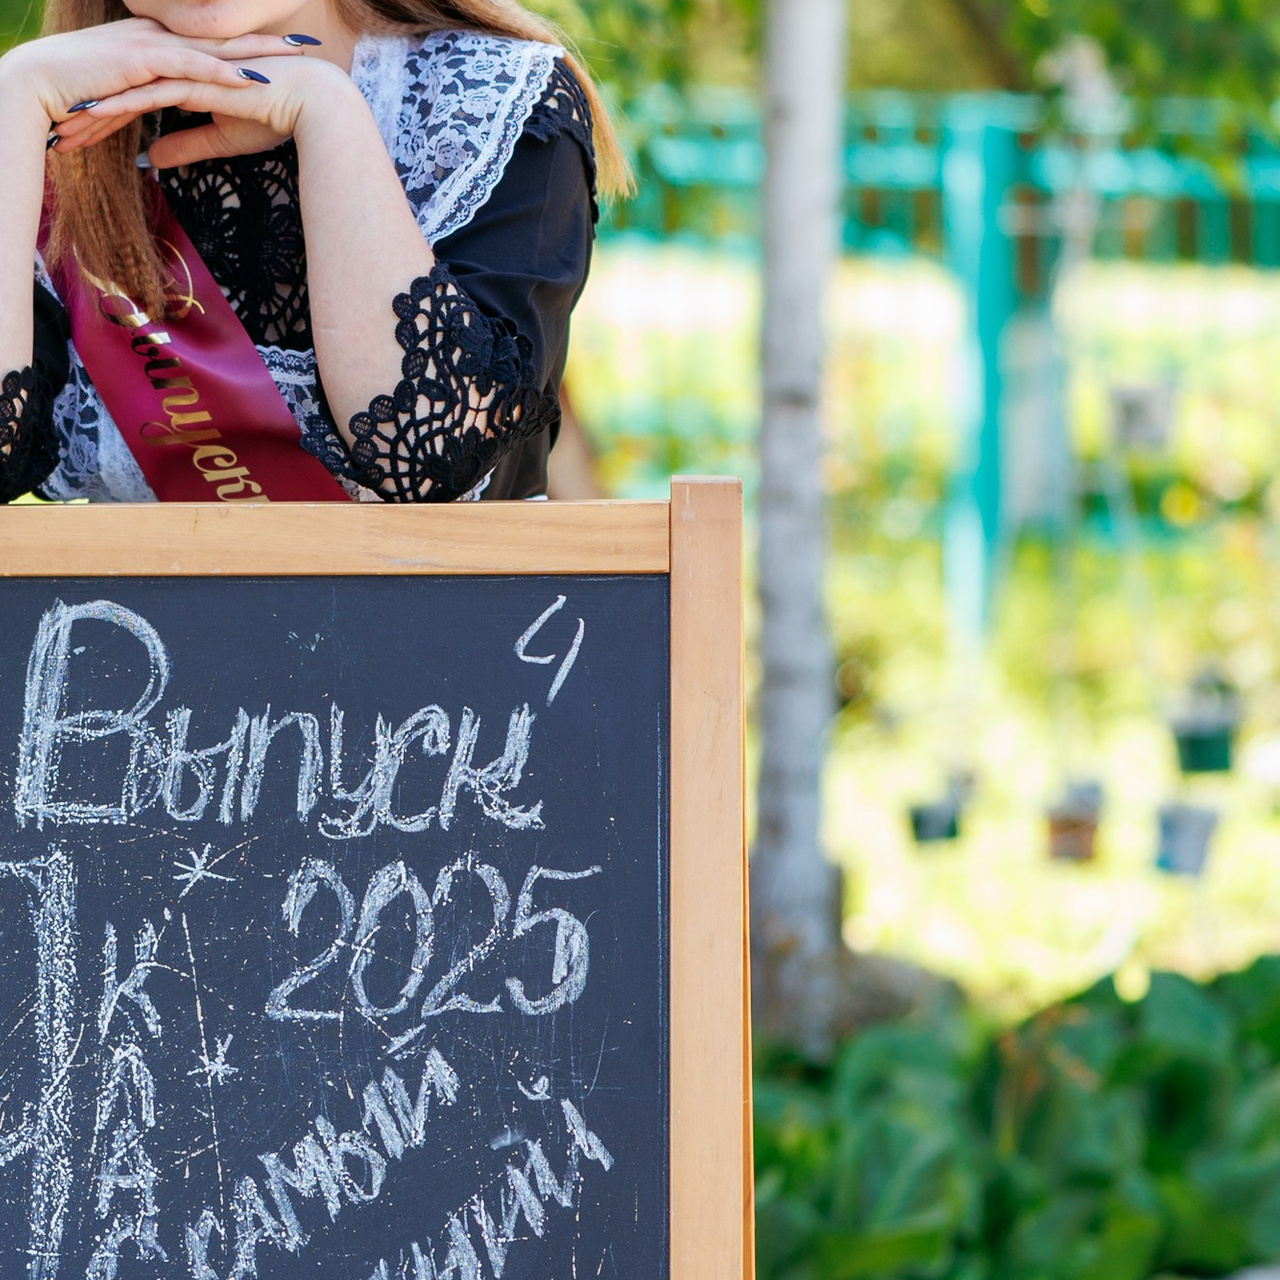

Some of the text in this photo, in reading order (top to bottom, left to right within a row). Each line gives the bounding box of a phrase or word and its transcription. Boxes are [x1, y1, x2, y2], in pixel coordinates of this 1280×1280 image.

[72, 235, 272, 502] ыпуск
[15, 597, 546, 839] Выпуск
[514, 594, 585, 706] 4
[266, 851, 603, 1021] 2025
